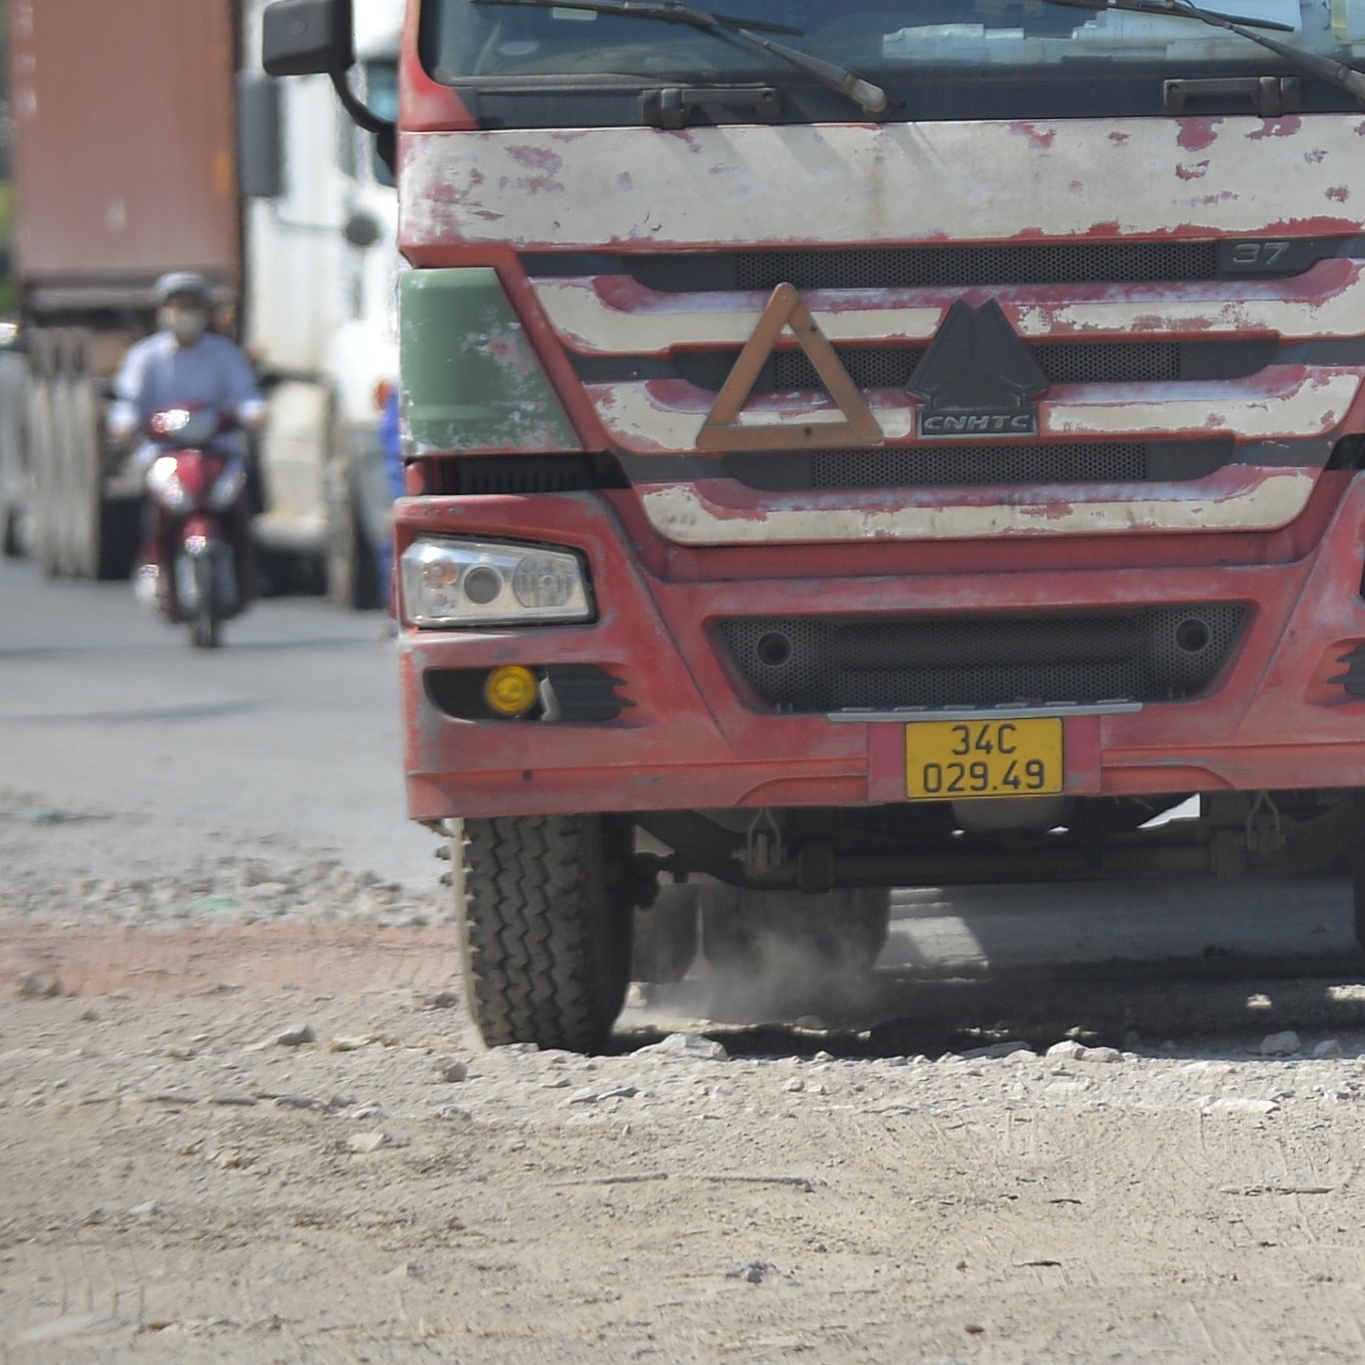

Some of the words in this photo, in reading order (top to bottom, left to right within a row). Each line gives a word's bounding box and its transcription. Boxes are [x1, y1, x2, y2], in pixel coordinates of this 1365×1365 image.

[1232, 242, 1290, 265] 37
[923, 413, 1032, 431] CNHTC
[952, 723, 1017, 755] 34C
[923, 759, 1045, 793] 029.49
